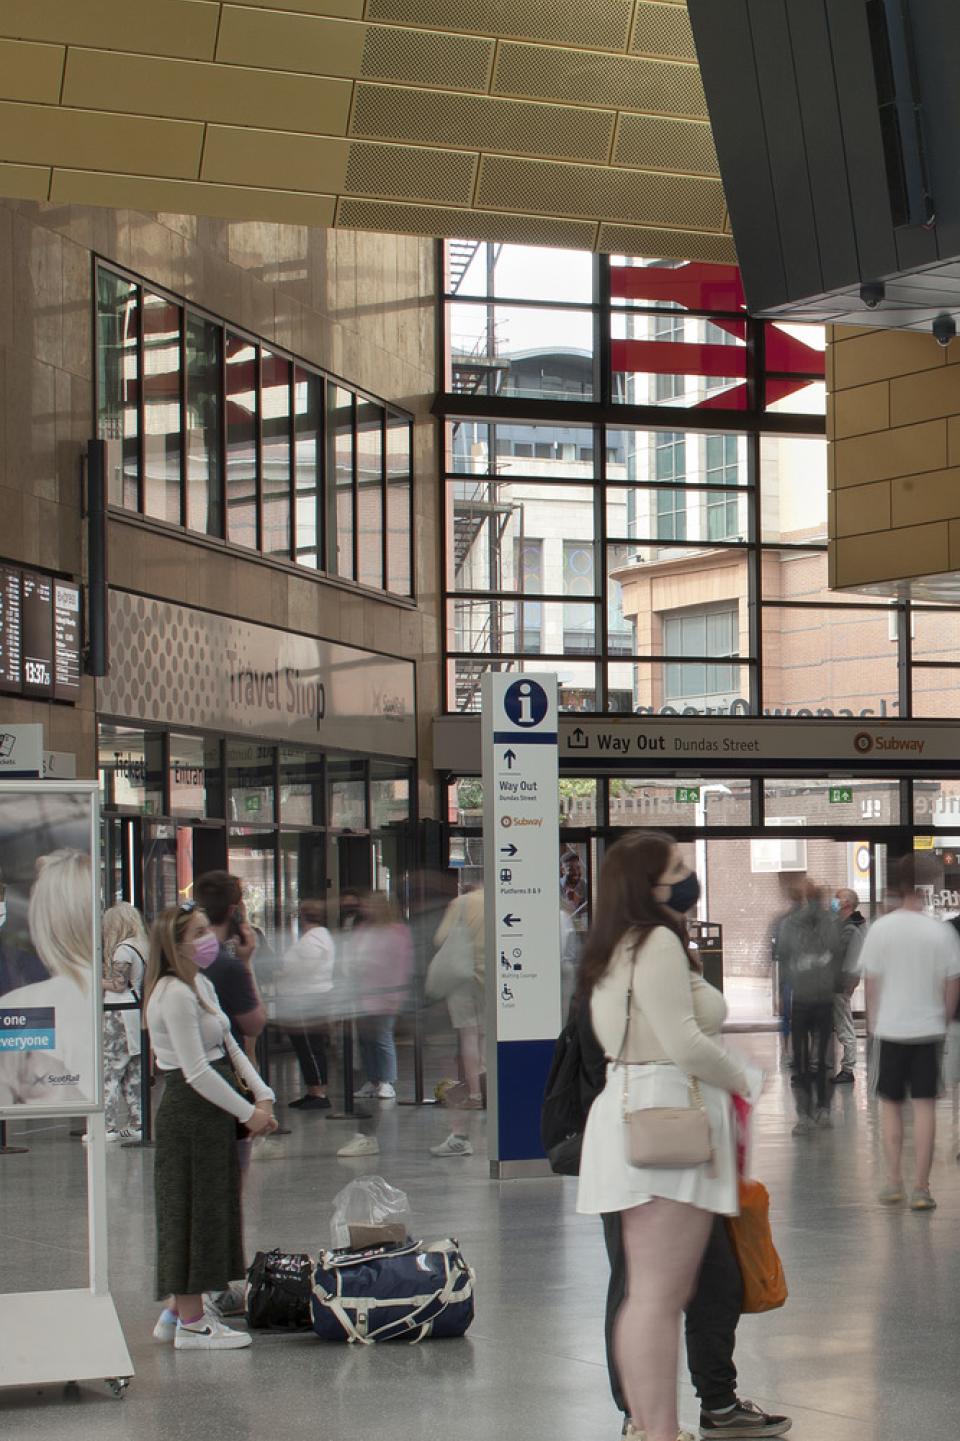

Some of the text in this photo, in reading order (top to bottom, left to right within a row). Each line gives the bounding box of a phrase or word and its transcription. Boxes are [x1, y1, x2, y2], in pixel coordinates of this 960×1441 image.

[225, 649, 326, 732] Travel Shop
[597, 734, 760, 754] Way Out Dundas Street
[875, 736, 925, 753] Subway
[500, 780, 537, 793] Way Out
[513, 817, 543, 828] Subway
[3, 1015, 27, 1026] one
[0, 1035, 49, 1050] veryone
[48, 1073, 80, 1084] ScotRail
